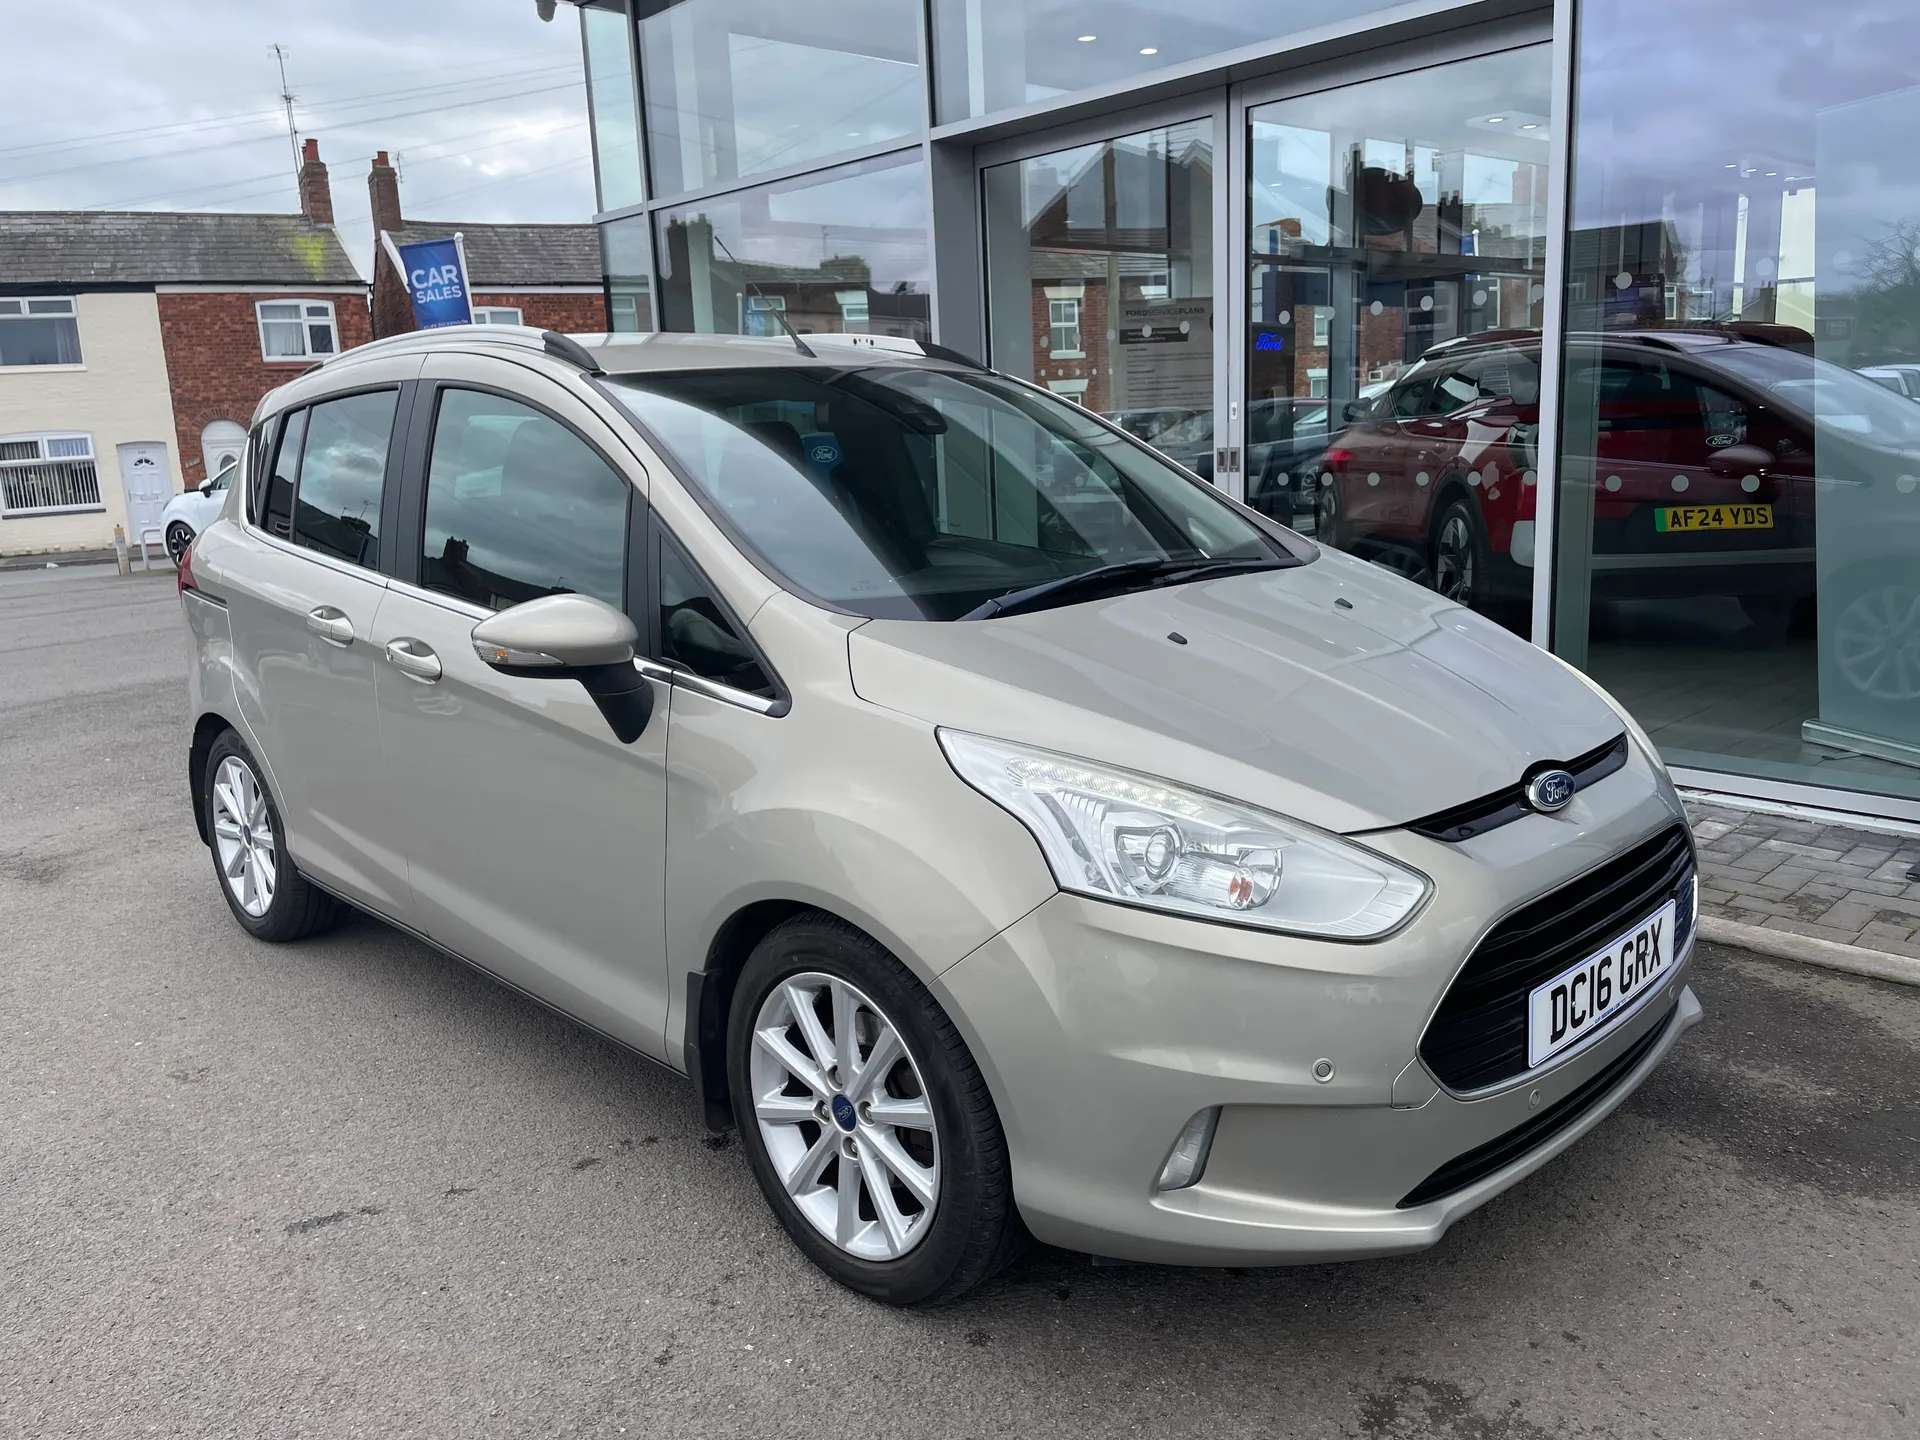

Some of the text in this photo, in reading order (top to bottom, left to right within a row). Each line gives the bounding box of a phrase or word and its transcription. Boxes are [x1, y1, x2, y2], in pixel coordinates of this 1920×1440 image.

[411, 265, 459, 289] CAR
[416, 285, 462, 304] SALES
[1256, 331, 1284, 351] Ford
[1671, 507, 1768, 528] AF24 YDS
[1545, 777, 1569, 802] Ford
[1550, 916, 1663, 1045] DC16 GRX
